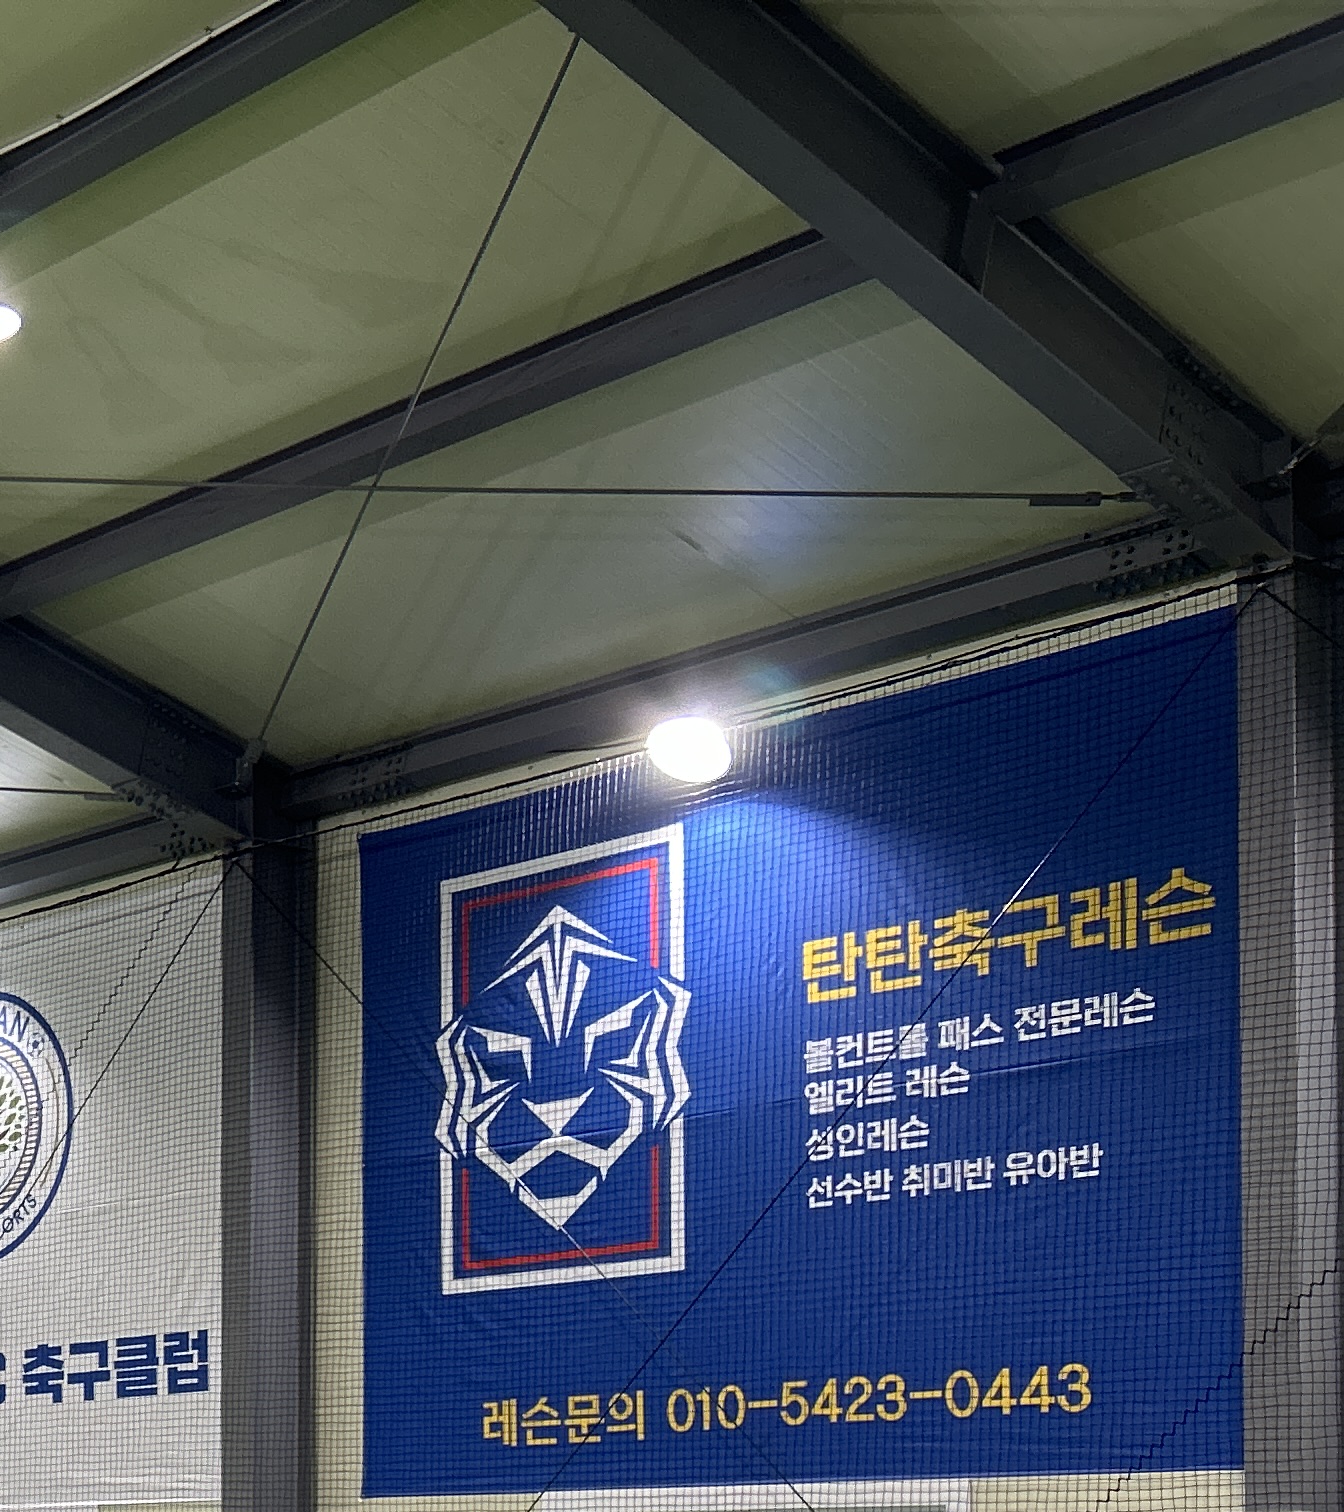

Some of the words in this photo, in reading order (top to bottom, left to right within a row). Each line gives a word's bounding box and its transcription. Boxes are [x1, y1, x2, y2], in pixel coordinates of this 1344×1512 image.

[801, 867, 1216, 1003] 탄탄축구레슨
[803, 1022, 929, 1074] 볼컨트롤
[937, 1012, 1004, 1051] 패스
[1013, 987, 1156, 1043] 전문레슨
[804, 1072, 897, 1115] 엘리트
[905, 1061, 970, 1098] 레슨
[805, 1114, 930, 1161] 성인레슨
[806, 1167, 894, 1209] 선수반
[901, 1155, 997, 1198] 취미반
[1002, 1142, 1104, 1186] 유아반
[21, 1328, 209, 1403] 축구클럽
[481, 1389, 646, 1447] 레슨문의
[666, 1363, 1091, 1433] 010-5423-0443
